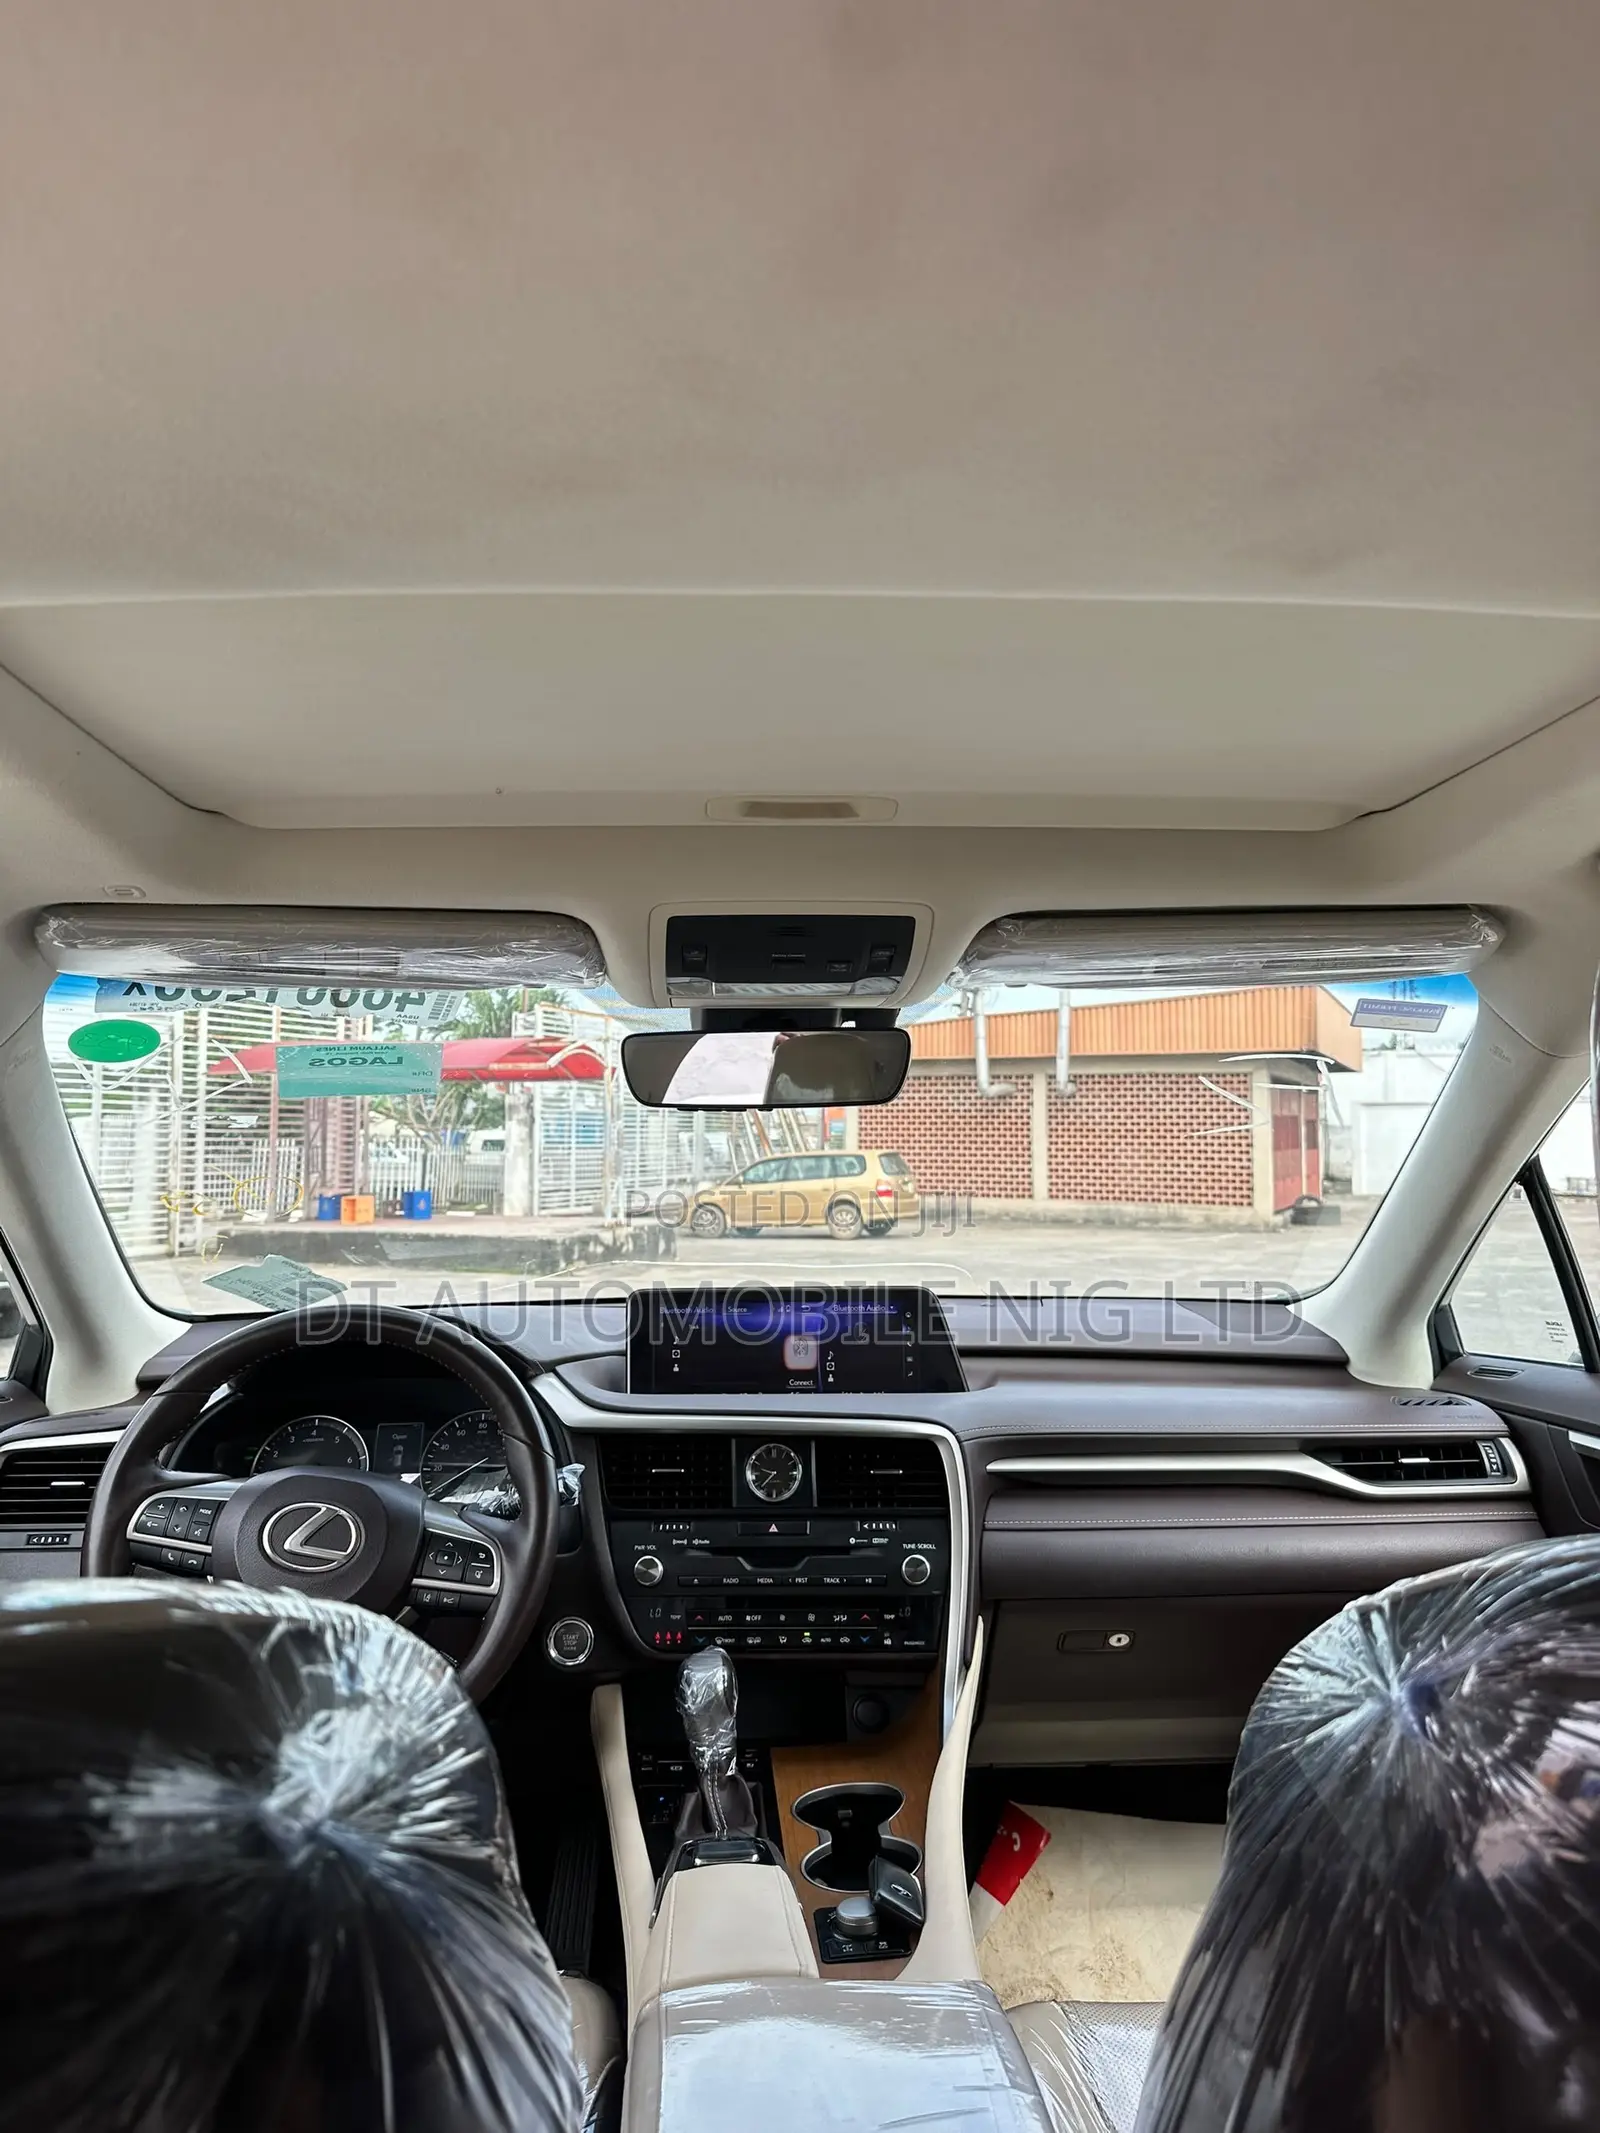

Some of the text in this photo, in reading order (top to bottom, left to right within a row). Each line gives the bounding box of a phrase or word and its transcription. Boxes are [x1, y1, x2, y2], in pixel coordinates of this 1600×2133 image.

[833, 1304, 887, 1312] Bluetooth Audio
[788, 1378, 814, 1386] Connect
[289, 1436, 295, 1444] 3
[334, 1436, 340, 1444] 5
[440, 1443, 450, 1451] 40
[273, 1450, 279, 1458] 2
[347, 1456, 353, 1464] 6
[433, 1464, 443, 1472] 20
